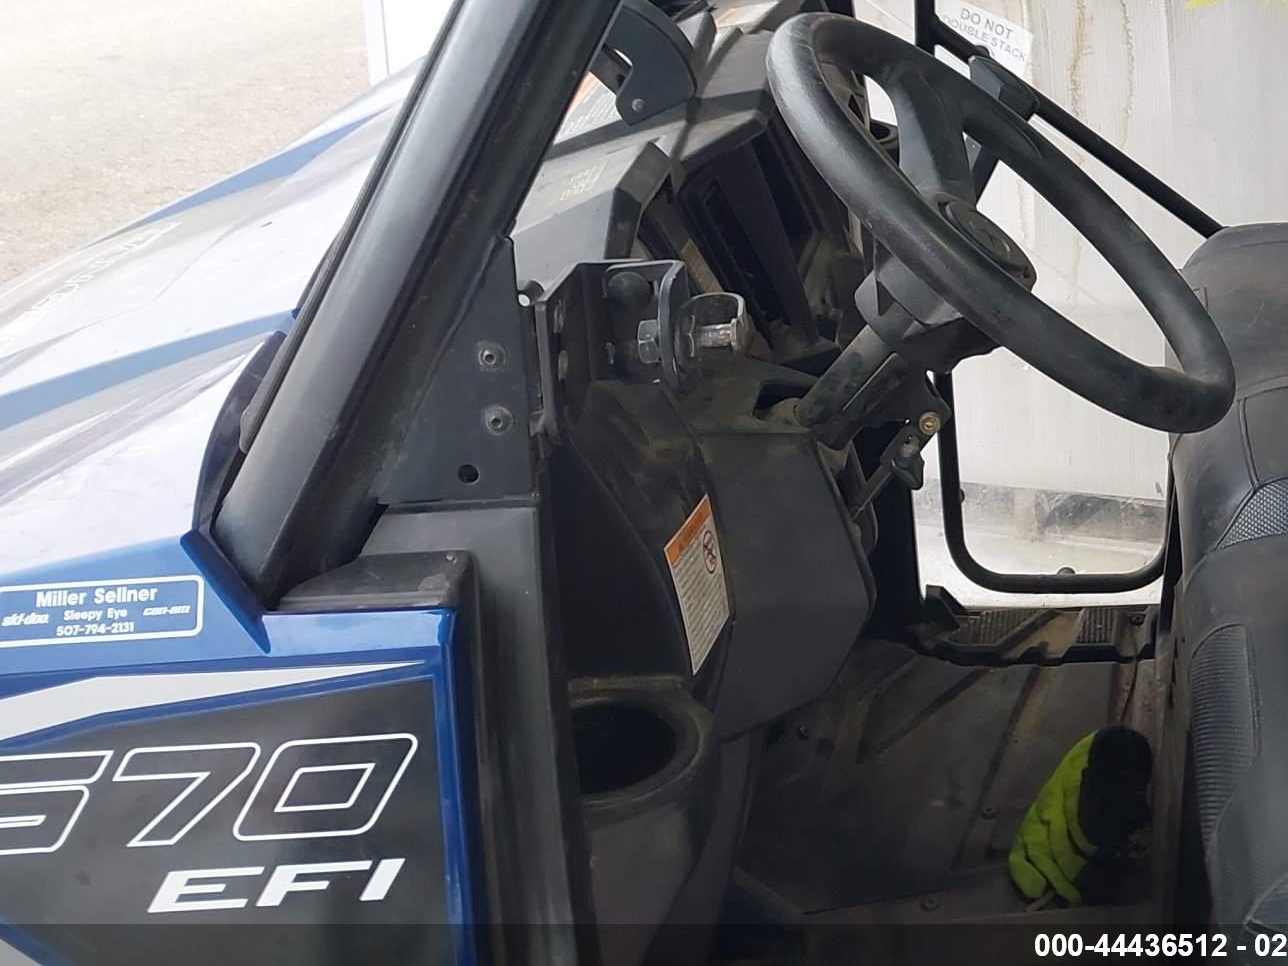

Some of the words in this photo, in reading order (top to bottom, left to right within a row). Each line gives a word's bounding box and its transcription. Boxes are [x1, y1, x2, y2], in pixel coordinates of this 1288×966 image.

[960, 7, 981, 26] DO
[985, 19, 1013, 40] NOT
[989, 36, 1026, 62] STACK
[36, 590, 87, 608] Miller
[94, 586, 158, 604] Sellner
[63, 609, 103, 621] Sleepy
[107, 607, 128, 620] Eye
[56, 621, 135, 637] 507-794-2131
[147, 858, 406, 914] EFI
